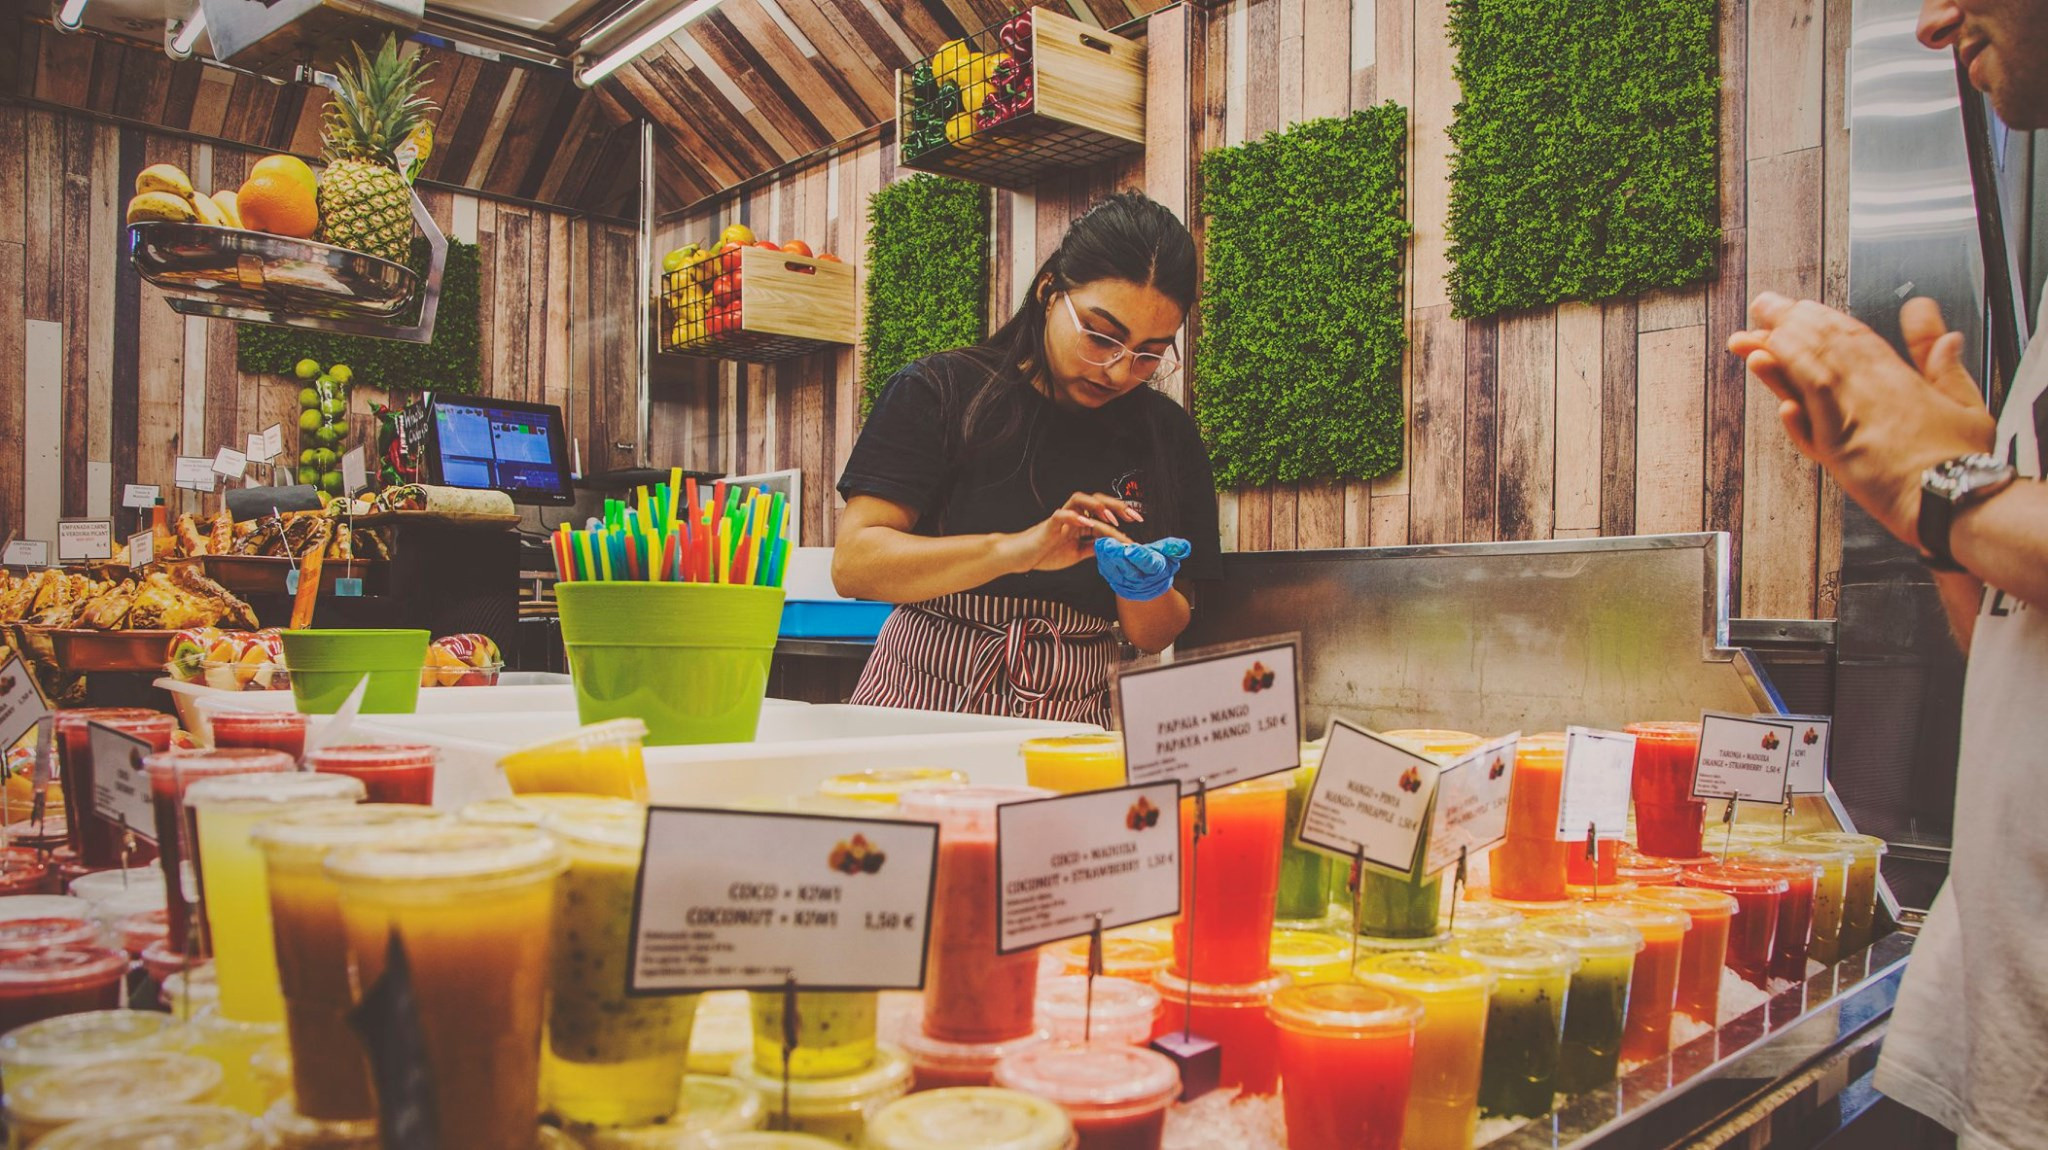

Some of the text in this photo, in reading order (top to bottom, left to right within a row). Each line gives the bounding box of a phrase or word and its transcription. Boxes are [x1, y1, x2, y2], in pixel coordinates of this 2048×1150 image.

[1209, 704, 1249, 723] MANGO
[1156, 735, 1201, 755] PAPAYA
[1211, 723, 1251, 742] MANGO
[1258, 715, 1278, 732] 1,50
[1702, 758, 1724, 768] ORANGE
[1729, 761, 1763, 772] STRAWBERRY
[1357, 801, 1395, 823] PINEAPPLE
[1051, 851, 1081, 868] COCO
[1006, 873, 1060, 894] COCONUT
[1072, 860, 1140, 882] STRAWBERRY
[728, 882, 779, 900] COCO
[797, 884, 841, 902] KIWI
[686, 906, 774, 928] COCONUT
[794, 910, 838, 928] KIWI
[864, 912, 899, 930] 1,50
[903, 913, 915, 930] €
